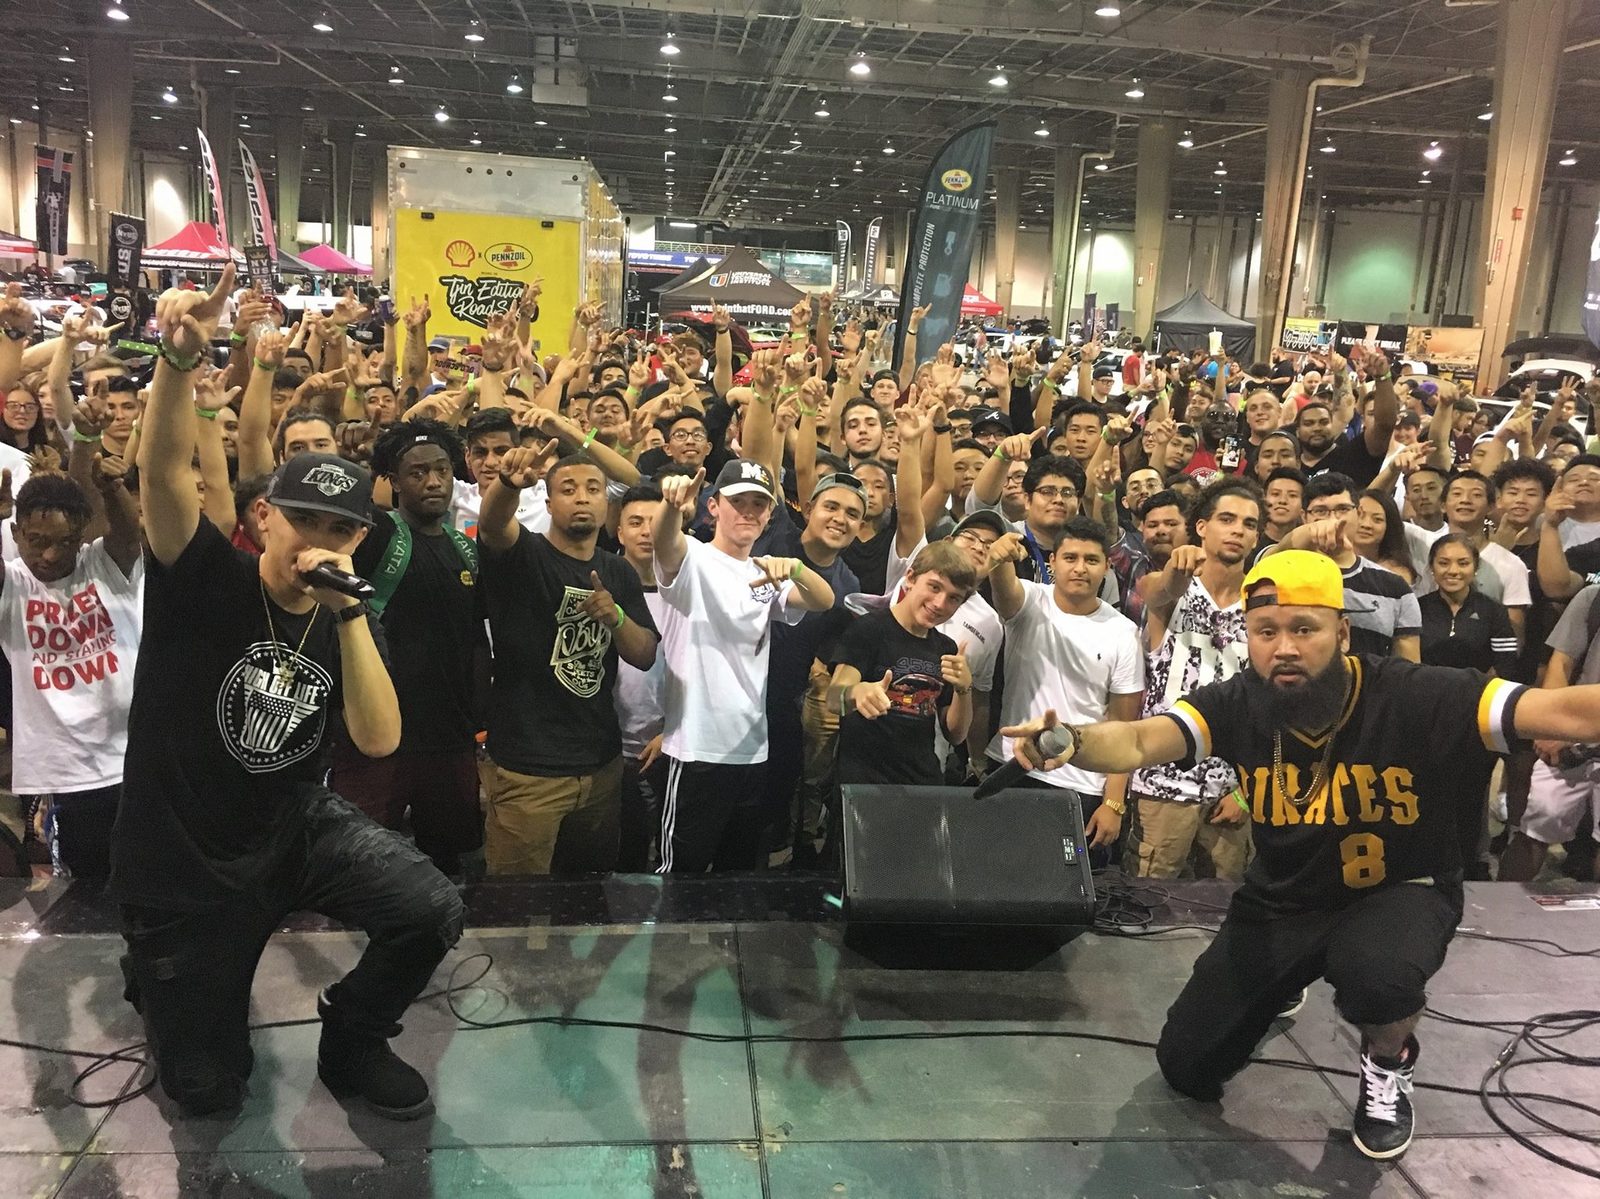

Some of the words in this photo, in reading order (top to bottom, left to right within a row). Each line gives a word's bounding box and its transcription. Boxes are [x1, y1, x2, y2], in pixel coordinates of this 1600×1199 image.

[925, 191, 979, 210] PLATINUM
[491, 252, 525, 262] PENNZOIL
[919, 222, 935, 271] PROTECTION
[479, 280, 523, 301] Editio
[294, 681, 320, 705] LIFE
[1339, 832, 1387, 889] 8
